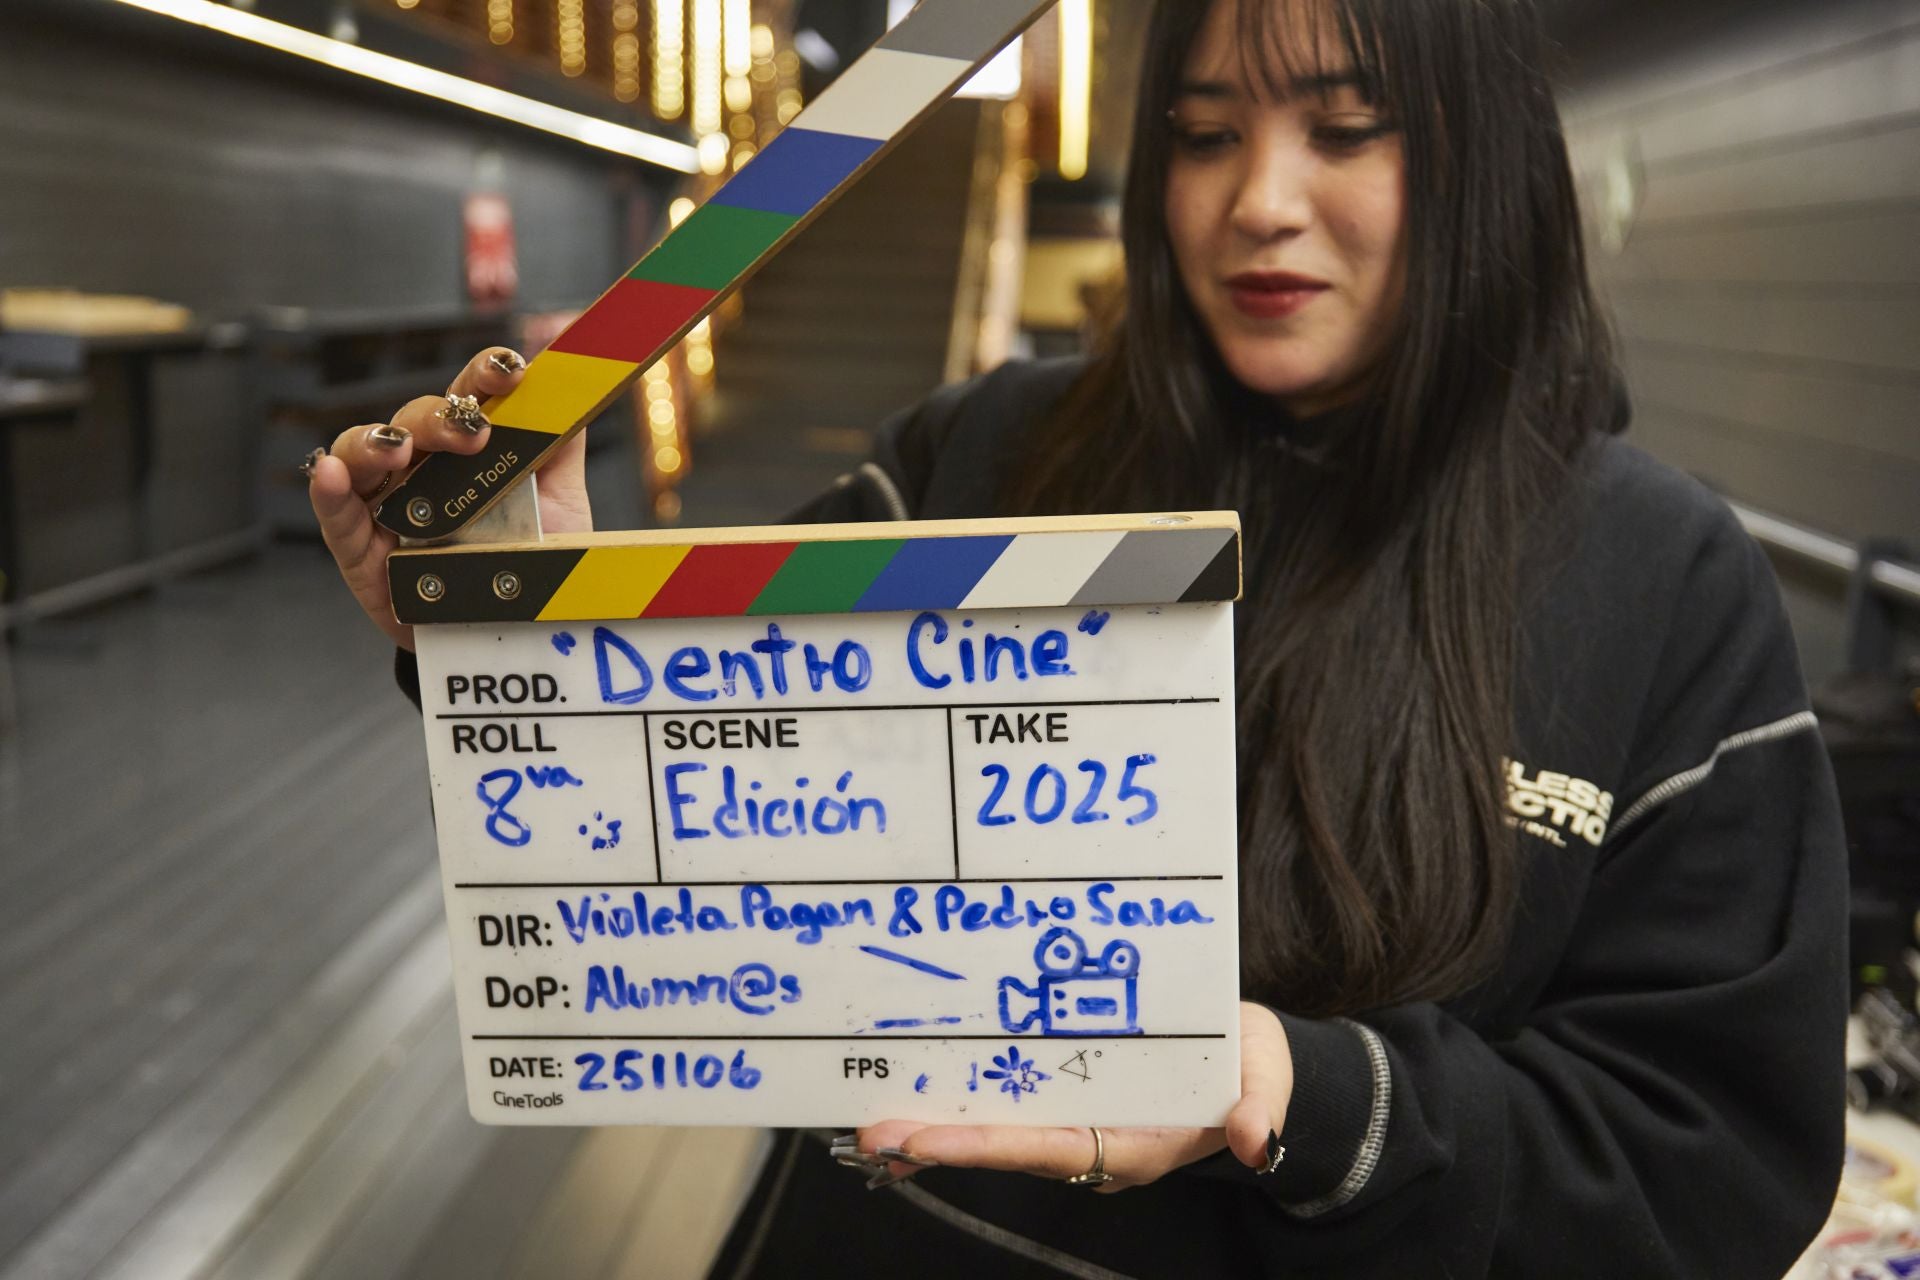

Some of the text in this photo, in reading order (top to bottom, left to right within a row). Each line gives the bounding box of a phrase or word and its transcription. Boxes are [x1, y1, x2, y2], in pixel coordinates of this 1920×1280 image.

[444, 451, 519, 518] Cine Tools
[446, 673, 567, 705] PROD.
[452, 722, 557, 754] ROLL
[663, 718, 800, 751] SCENE
[965, 712, 1069, 745] TAKE
[664, 761, 887, 841] Edición
[976, 753, 1158, 828] 2025
[556, 888, 738, 944] Violeta
[887, 885, 923, 938] &
[934, 884, 1078, 932] Pedro
[478, 914, 553, 949] DIR:
[485, 975, 571, 1009] DoP:
[585, 962, 802, 1016] Alumn@s
[489, 1056, 563, 1078] DATE:
[574, 1049, 762, 1092] 251106
[843, 1057, 889, 1079] FPS
[493, 1090, 564, 1109] CineTools
